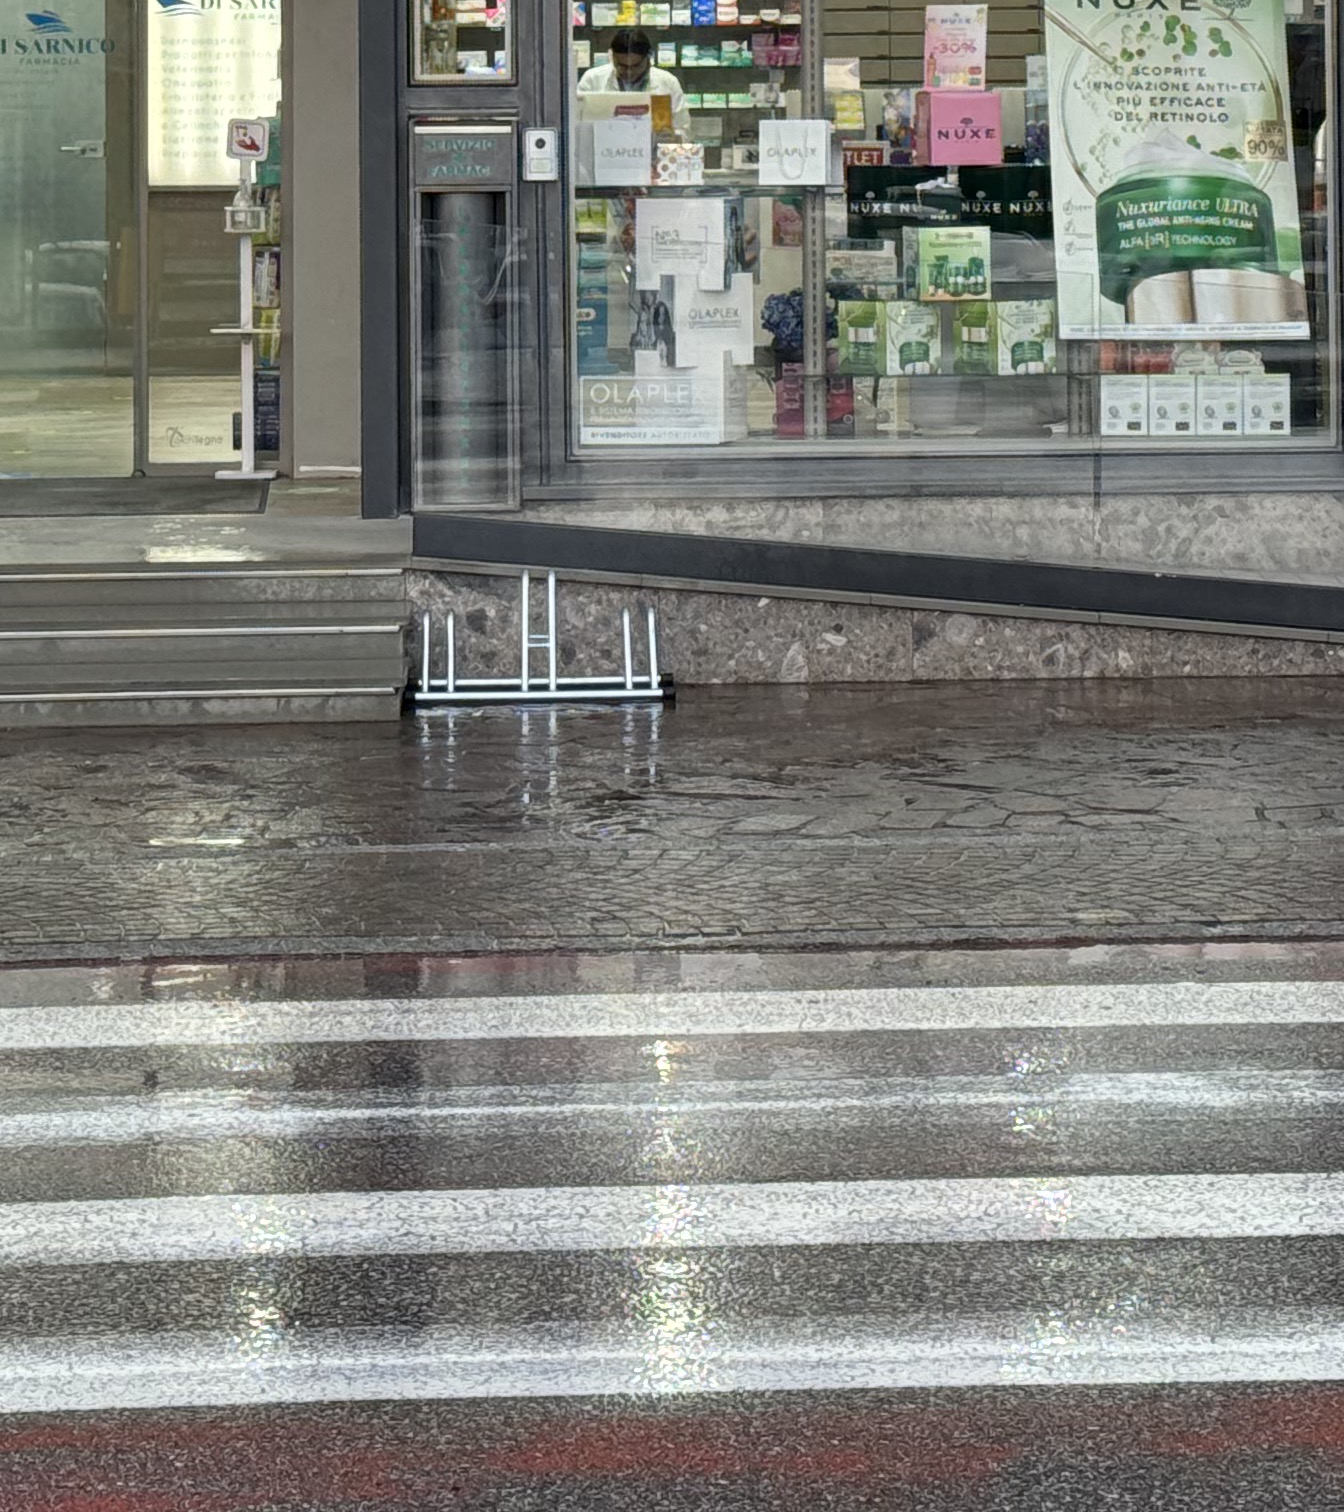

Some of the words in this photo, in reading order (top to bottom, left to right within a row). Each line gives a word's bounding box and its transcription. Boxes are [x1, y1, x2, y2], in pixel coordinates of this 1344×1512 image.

[14, 37, 116, 55] SARNICO
[932, 42, 977, 54] -30%
[19, 57, 81, 66] FARMACIA
[1131, 66, 1207, 77] SCOPRITE
[1196, 80, 1268, 93] ANTI-ETÀ
[1116, 94, 1142, 107] PIÙ
[1149, 97, 1226, 108] EFFICACE
[1113, 111, 1144, 123] DEL
[1149, 112, 1230, 123] RETINOLO
[937, 128, 996, 140] NUXE
[600, 148, 645, 158] OLAPLEX
[1246, 138, 1286, 157] 90%
[849, 202, 892, 214] NUXE
[961, 202, 1003, 214] NUXE
[1115, 197, 1210, 218] Nuxuriance
[1215, 197, 1258, 218] ULTRA
[1117, 220, 1135, 232] THE
[1136, 216, 1170, 228] GLOBAL
[1222, 218, 1254, 230] CREAM
[1119, 236, 1144, 250] ALFA
[1172, 234, 1237, 246] TECHNOLOGY
[688, 308, 740, 320] OLAPLEX
[589, 382, 705, 405] OLAPLEX
